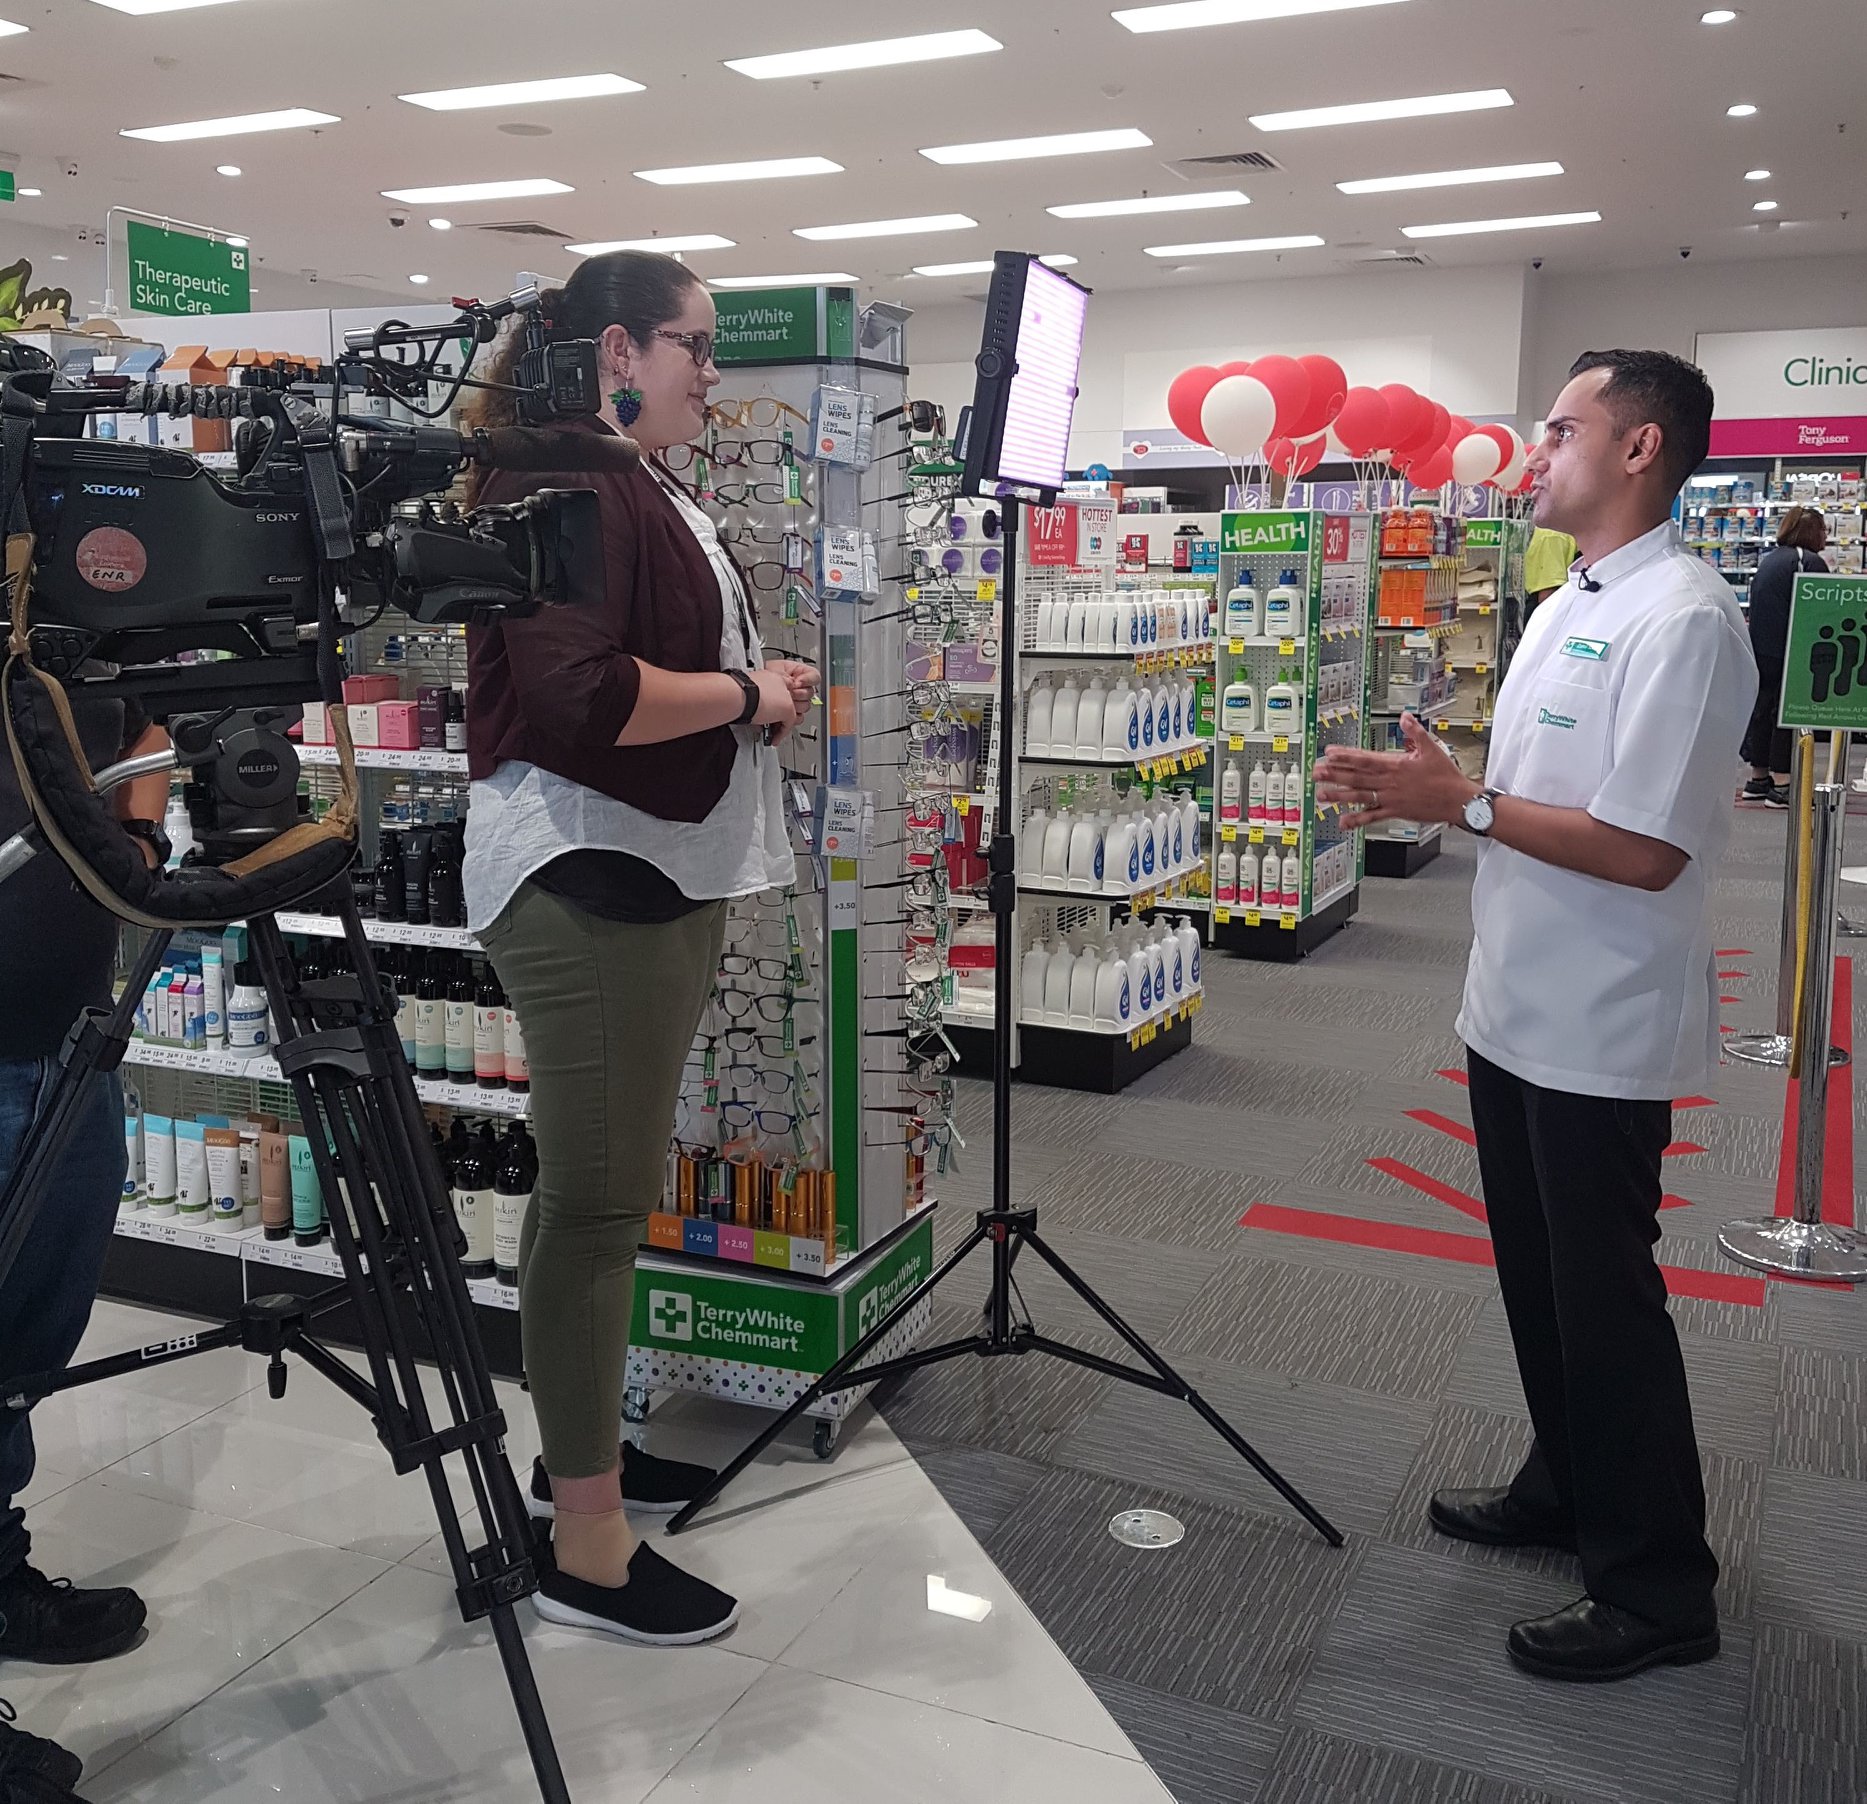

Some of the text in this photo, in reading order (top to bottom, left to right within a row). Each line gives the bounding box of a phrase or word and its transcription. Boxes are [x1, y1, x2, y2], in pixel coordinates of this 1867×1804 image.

[134, 260, 230, 296] Therapeutic
[136, 284, 212, 315] Skin Care
[1784, 356, 1867, 387] Clinic
[827, 403, 847, 412] LENS
[827, 410, 852, 420] WIPES
[822, 420, 838, 428] LENS
[822, 427, 852, 437] CLEANING
[1798, 424, 1827, 436] Tony
[1798, 435, 1849, 446] Ferguson
[256, 512, 301, 523] SONY
[1082, 508, 1112, 523] HOTTEST
[1092, 523, 1107, 533] STORE
[1225, 520, 1306, 549] HEALTH
[1466, 530, 1501, 543] ALTH
[830, 537, 850, 545] LENS
[831, 544, 855, 552] WIPES
[829, 559, 858, 567] CLEANING
[1311, 519, 1322, 598] HEALTH
[92, 570, 126, 581] ENR
[268, 575, 303, 584] Exmor
[460, 588, 500, 598] Canon
[1801, 582, 1867, 606] Scripts
[1228, 600, 1253, 611] Cetaphil
[1267, 600, 1289, 611] Cetaphil
[1308, 622, 1318, 699] HEALTH
[1225, 698, 1251, 707] Cetaphil
[1267, 699, 1291, 708] Cetaphil
[1306, 722, 1315, 797] HEALTH
[238, 764, 273, 774] MILLER
[834, 801, 852, 809] LENS
[834, 808, 856, 817] WIPES
[827, 825, 856, 833] CLEANING
[1303, 820, 1312, 895] HEALTH
[834, 902, 856, 910] +3.50
[696, 1233, 713, 1243] 2.00
[731, 1239, 748, 1249] 2.50
[767, 1246, 784, 1256] 3.00
[803, 1253, 821, 1263] 3.50
[879, 1255, 921, 1302] TerryWhite
[696, 1300, 805, 1334] TerryWhite
[696, 1320, 798, 1353] Chemmart
